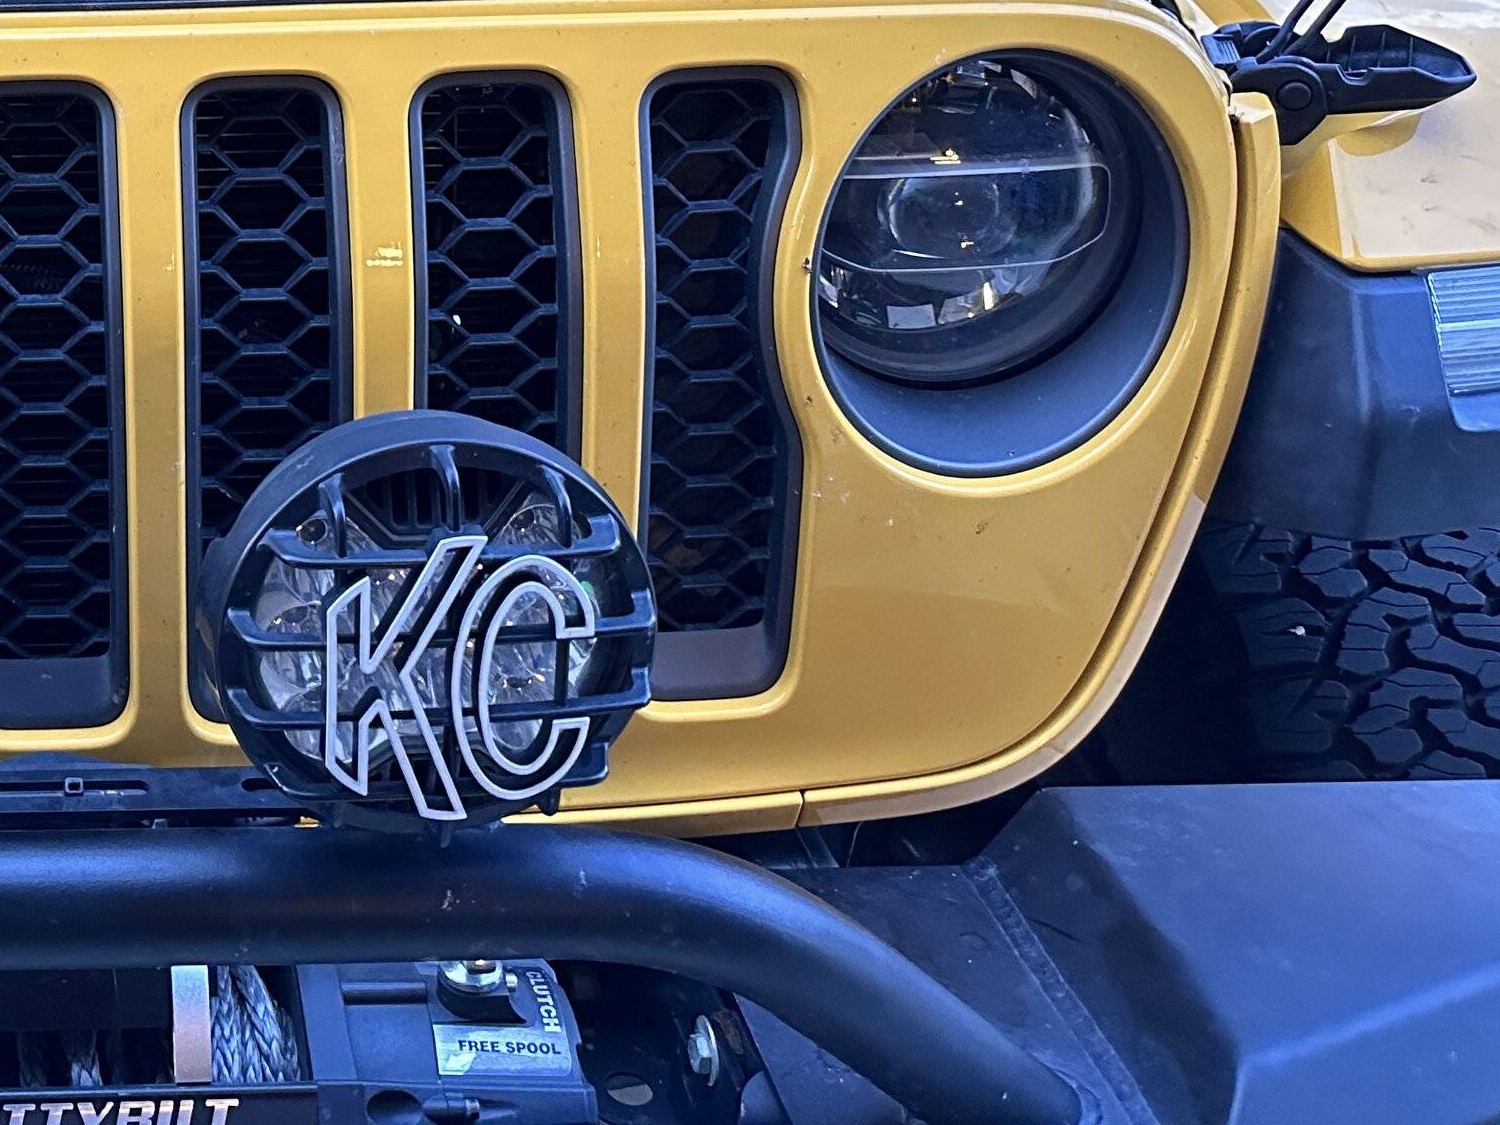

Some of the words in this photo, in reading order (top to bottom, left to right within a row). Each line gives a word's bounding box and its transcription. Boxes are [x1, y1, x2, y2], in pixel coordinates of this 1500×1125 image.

[325, 535, 596, 821] KC
[526, 971, 562, 1033] CLUTCH
[458, 1040, 500, 1052] FREE
[505, 1042, 562, 1055] SPOOL
